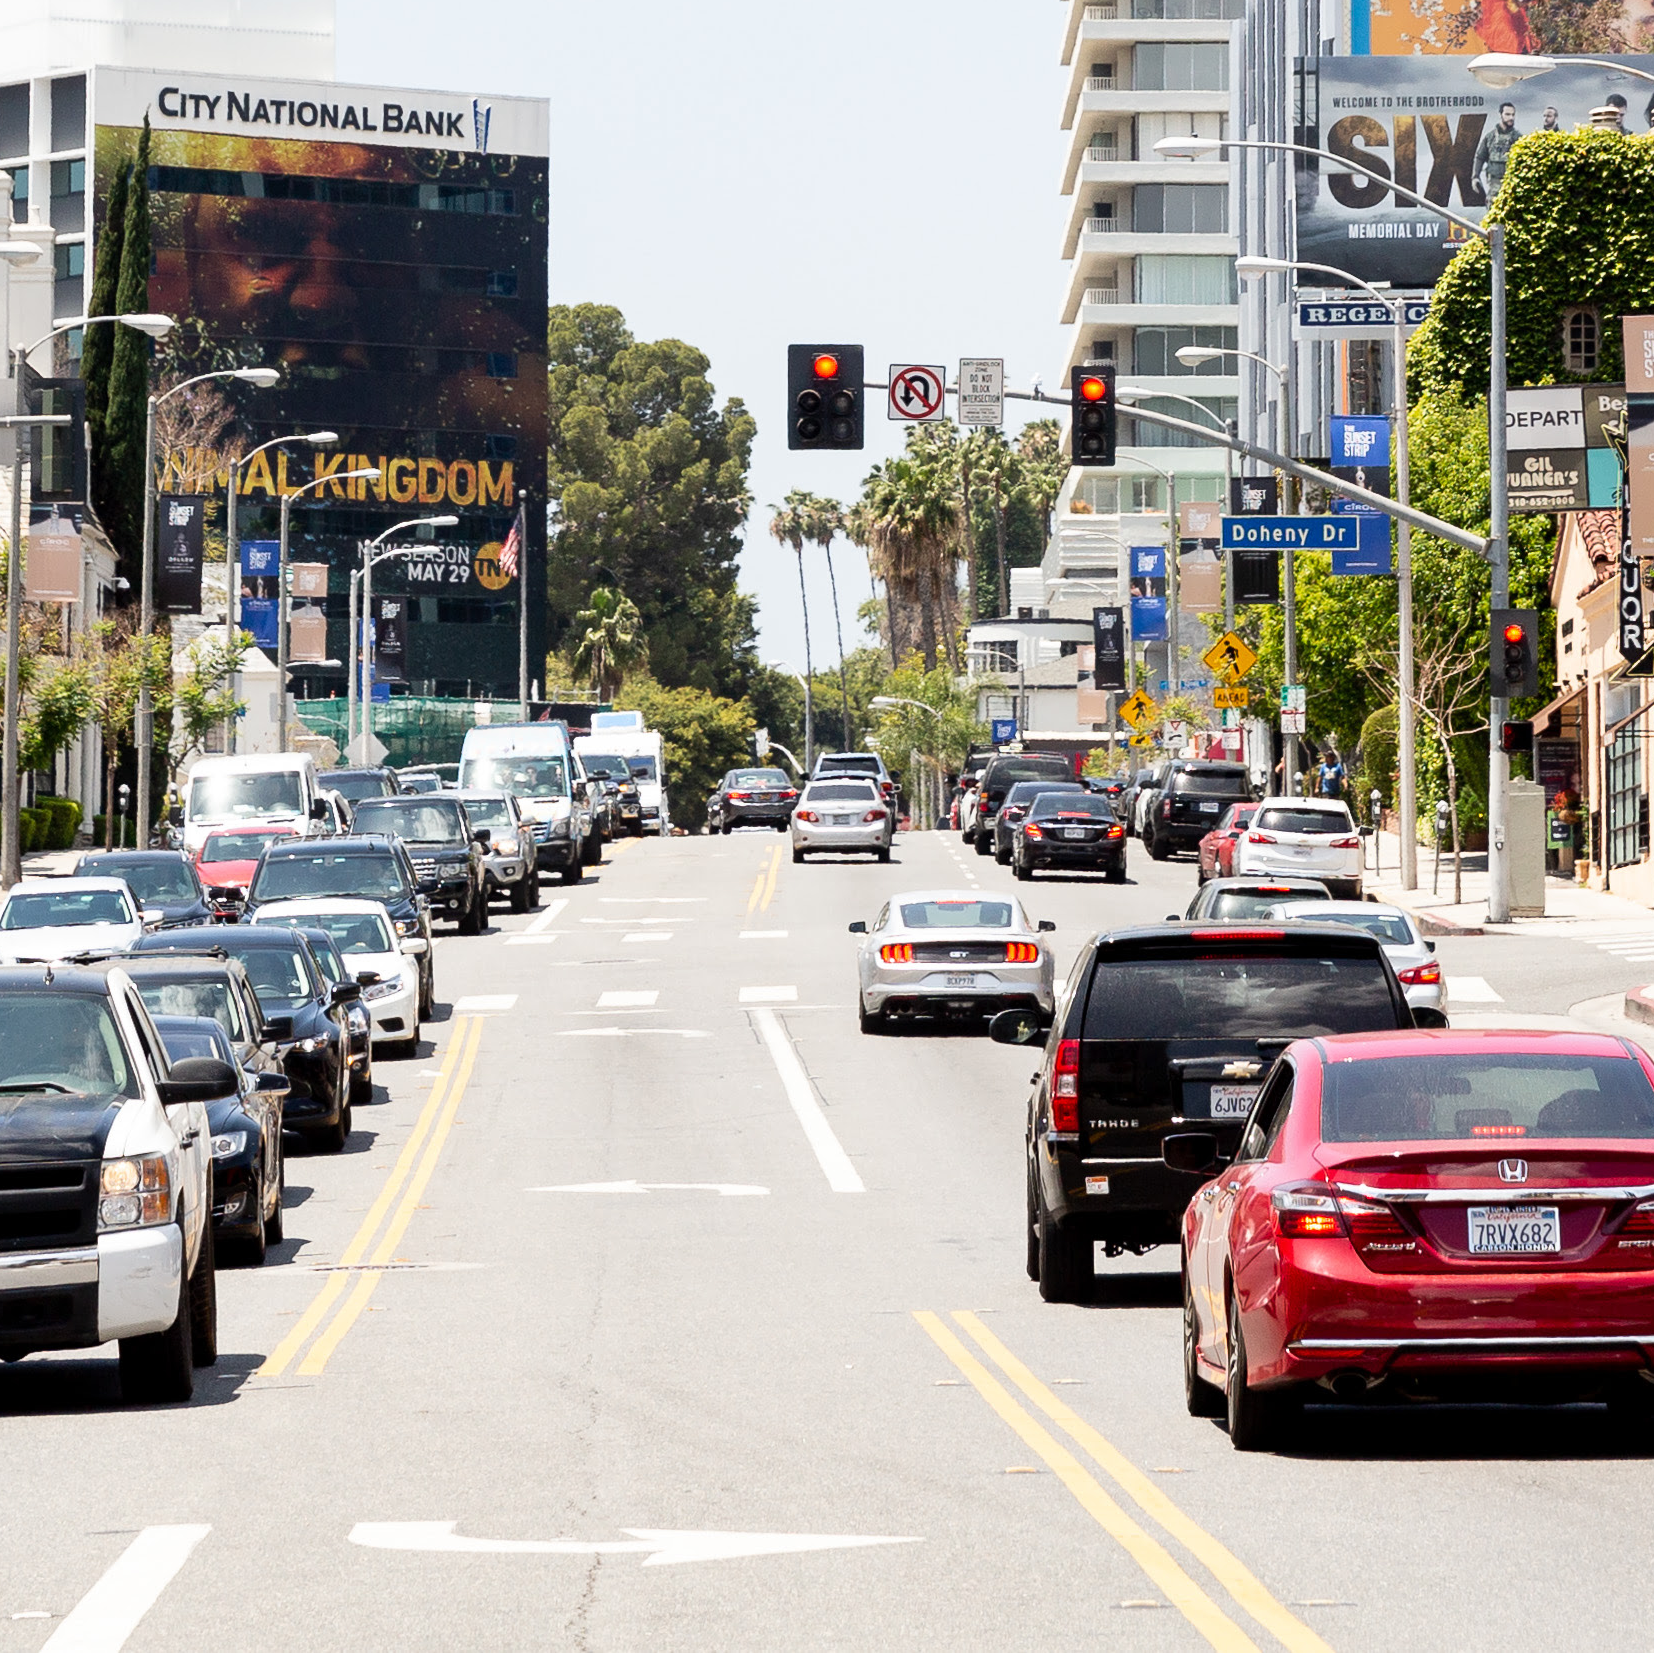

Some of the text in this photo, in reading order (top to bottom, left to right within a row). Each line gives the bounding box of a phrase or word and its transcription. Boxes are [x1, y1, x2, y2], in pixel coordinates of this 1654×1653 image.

[1333, 96, 1485, 108] WELCOME TO THE BROTHERHOOD
[1327, 113, 1488, 209] SIX
[1348, 223, 1440, 239] MEMORIAL DAY
[1307, 306, 1430, 323] REGEC
[969, 374, 993, 383] DO NOT
[972, 384, 991, 393] BLOCK
[1343, 431, 1376, 444] SUNSET
[1344, 444, 1370, 457] STRIP
[1524, 456, 1554, 472] GIL
[314, 451, 514, 506] KINGDOM
[1507, 471, 1579, 487] URNER'S
[1232, 524, 1346, 546] Doheny Dr
[407, 562, 470, 583] MAY 29
[1089, 1119, 1140, 1128] TAHOE
[1475, 1223, 1553, 1245] 7RVX682
